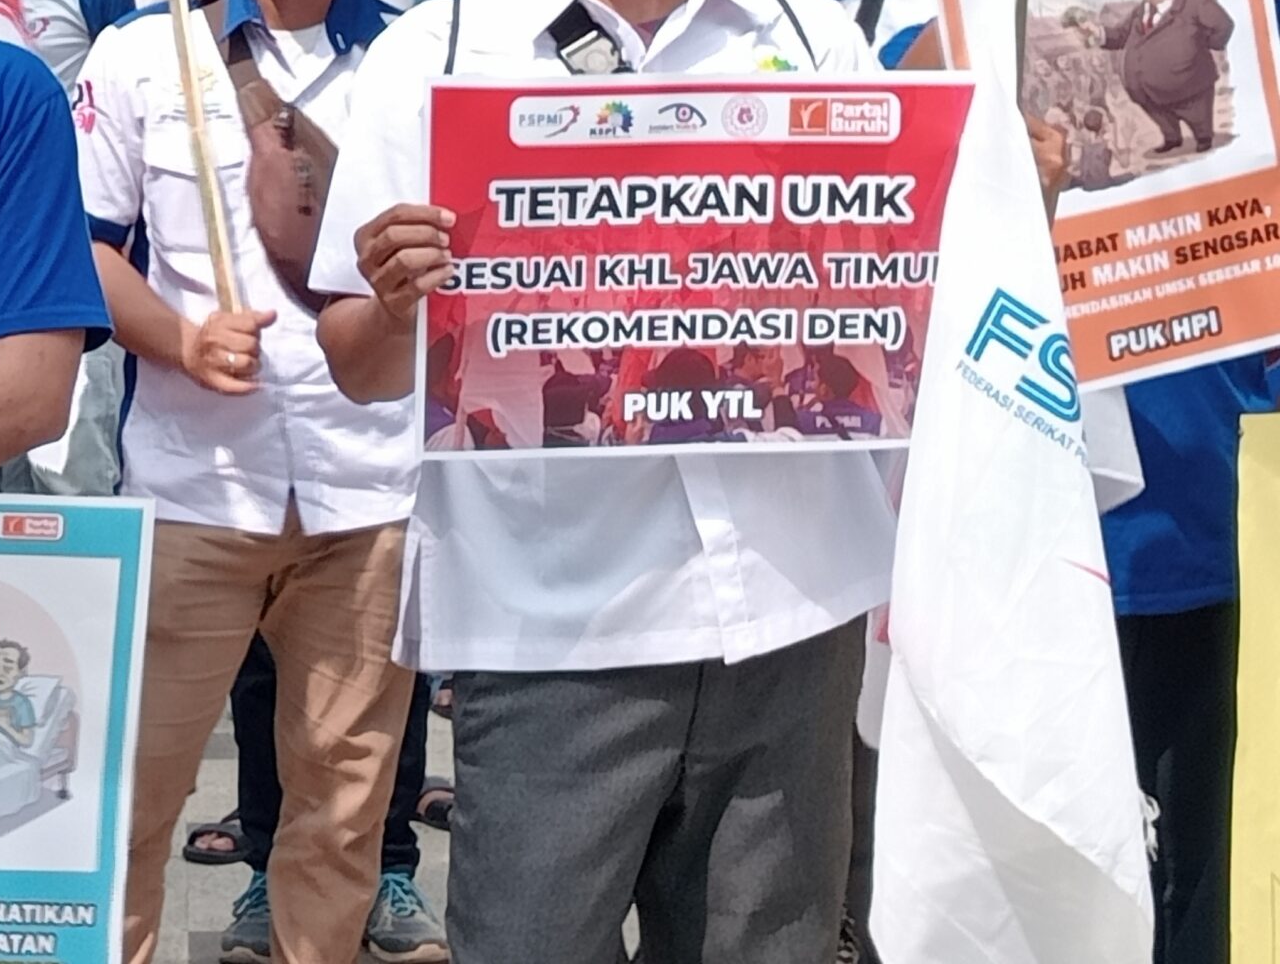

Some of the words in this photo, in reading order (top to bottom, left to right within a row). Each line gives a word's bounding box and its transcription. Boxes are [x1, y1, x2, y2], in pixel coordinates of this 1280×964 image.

[831, 101, 890, 120] Partai
[831, 118, 890, 135] Buruh
[495, 181, 770, 222] TETAPKAN
[788, 181, 912, 219] UMK
[1125, 213, 1202, 250] MAKIN
[1206, 197, 1272, 228] KAYA,
[442, 259, 584, 291] SESUAI
[597, 257, 678, 286] KHL
[688, 256, 815, 286] JAWA
[1091, 250, 1170, 287] MAKIN
[489, 313, 793, 354] (REKOMENDASI
[808, 310, 904, 348] DEN)
[1110, 326, 1168, 359] PUK
[1171, 309, 1219, 343] HPI
[624, 393, 692, 422] PUK
[701, 391, 762, 420] YTL
[956, 359, 1014, 410] FEDERASI
[1013, 404, 1076, 451] SERIKAT
